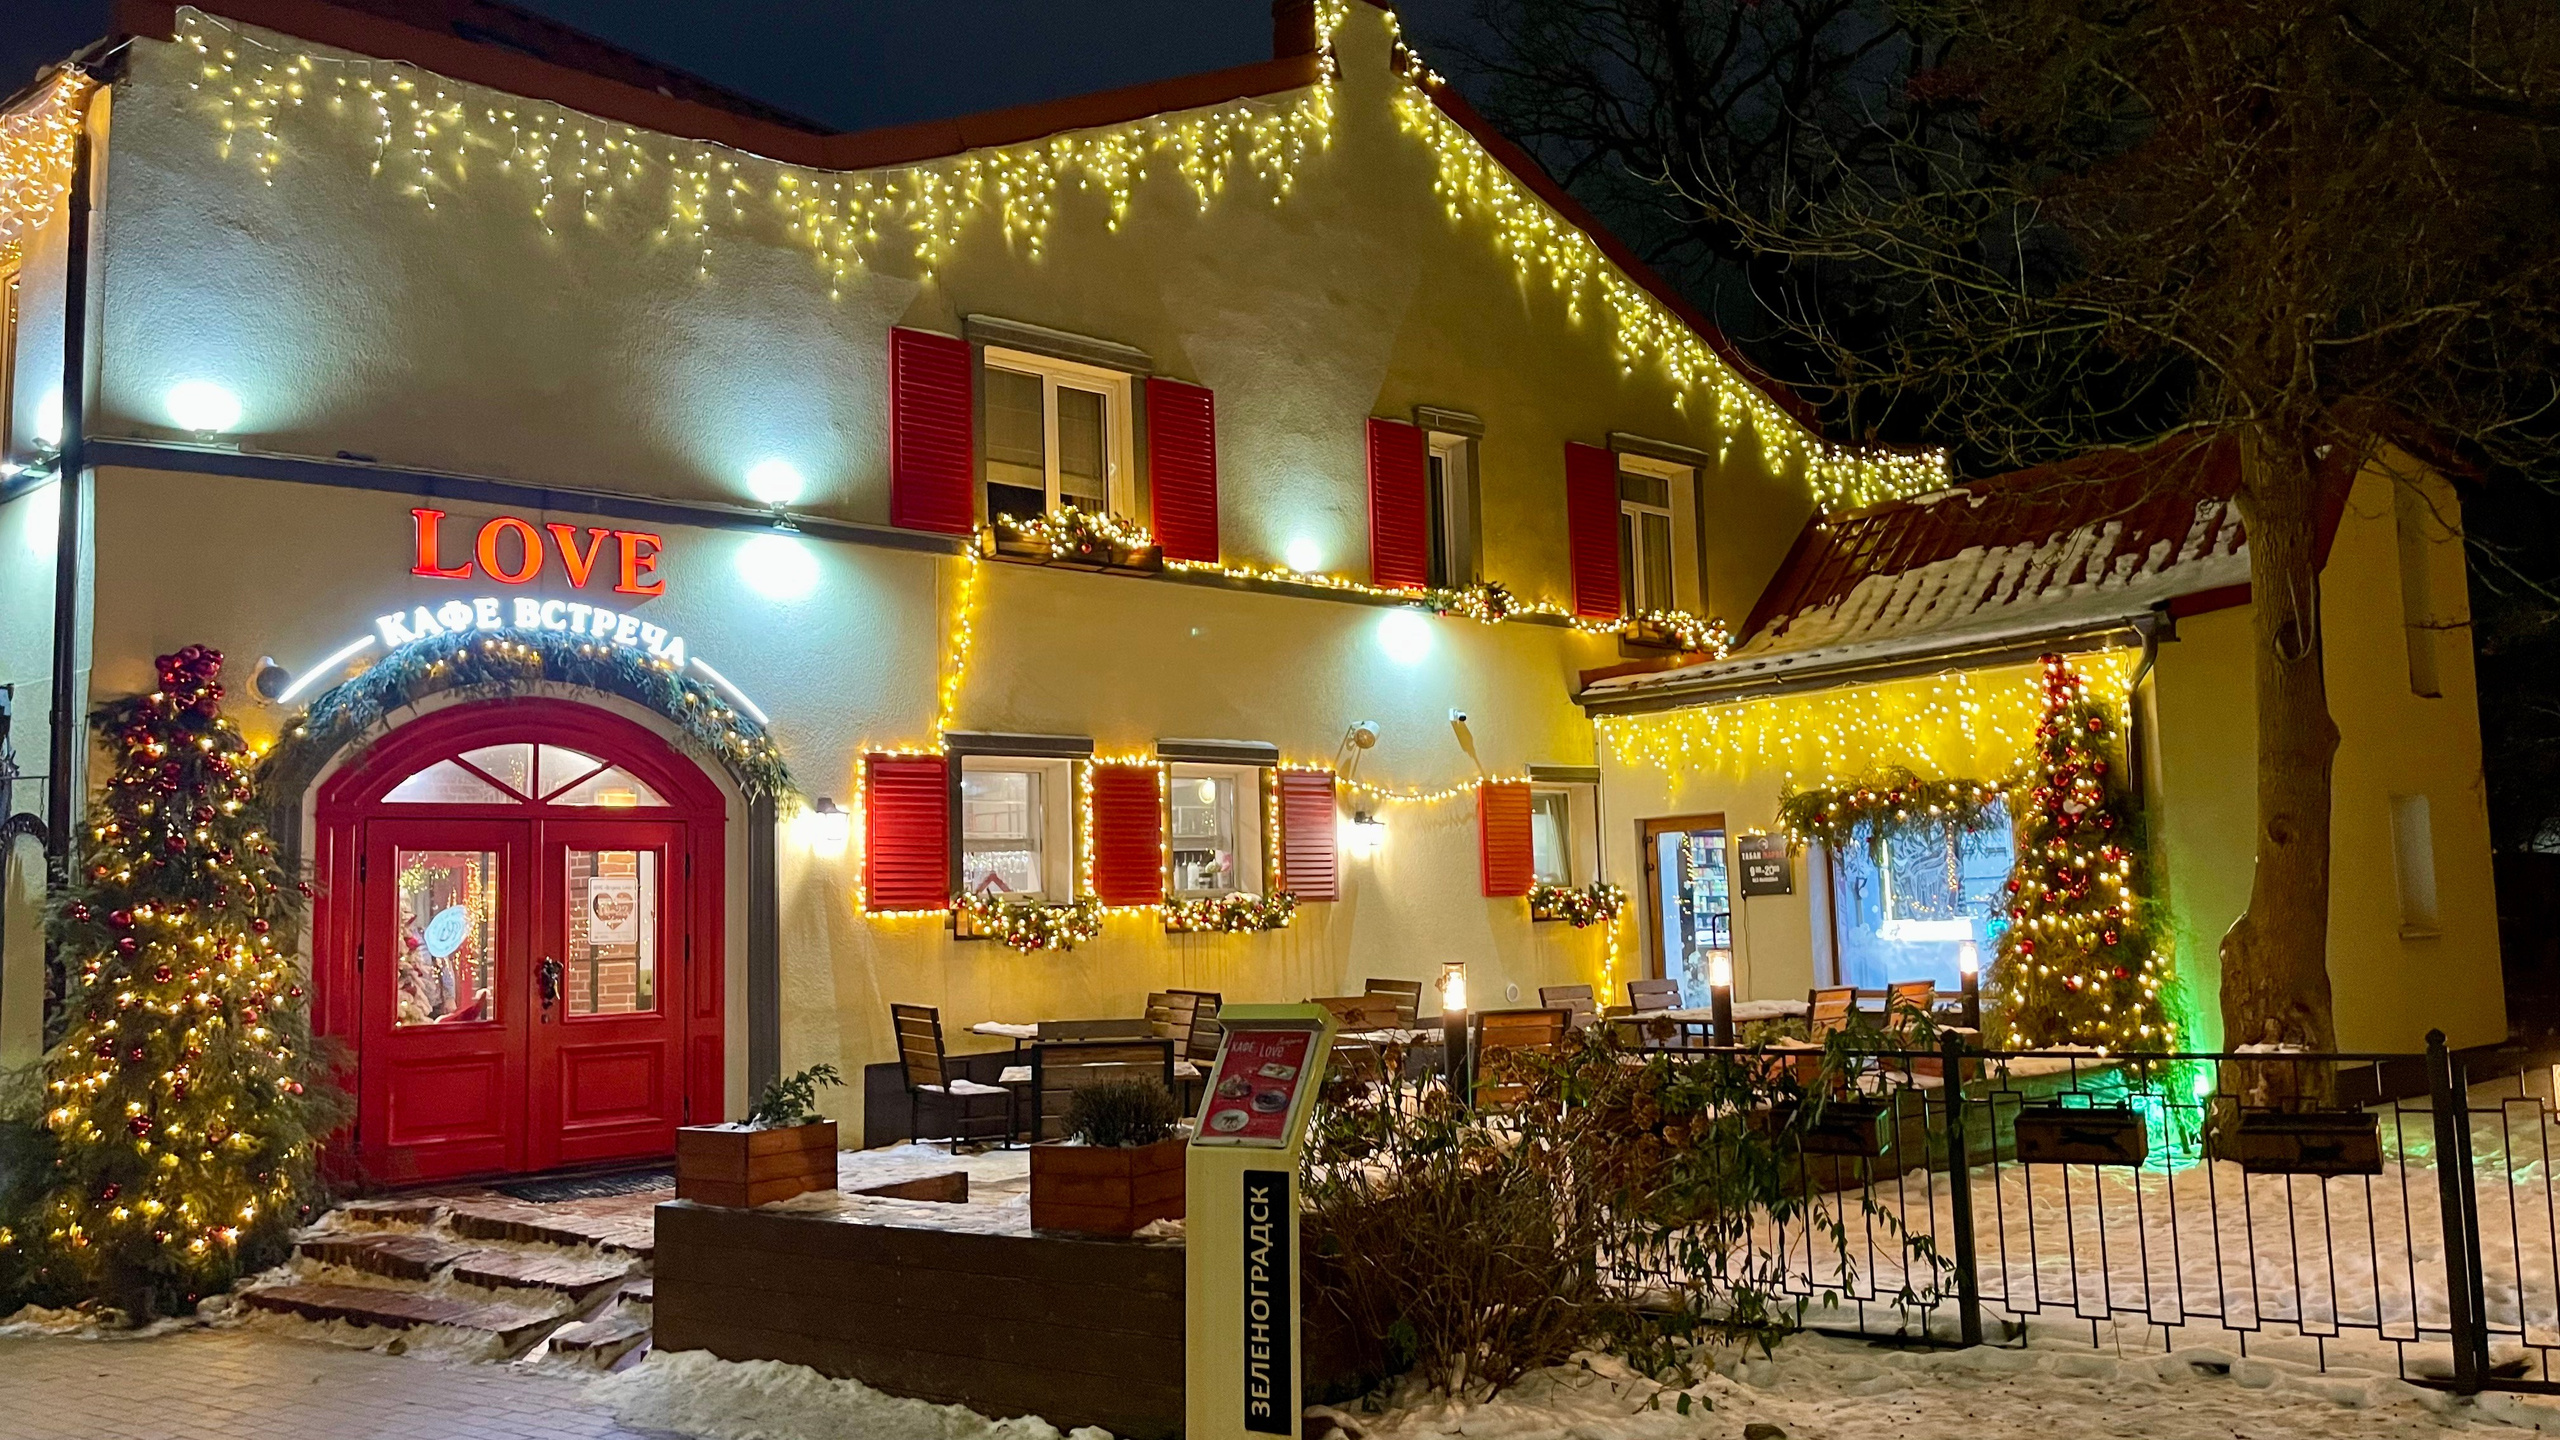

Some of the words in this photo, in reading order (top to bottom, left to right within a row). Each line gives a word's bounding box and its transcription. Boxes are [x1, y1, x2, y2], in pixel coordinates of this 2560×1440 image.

[411, 507, 667, 596] LOVE
[376, 597, 502, 648] КАФЕ
[513, 597, 686, 667] ВСТРЕЧА
[1250, 1186, 1274, 1418] ЗЕЛЕНОГРАДСК
